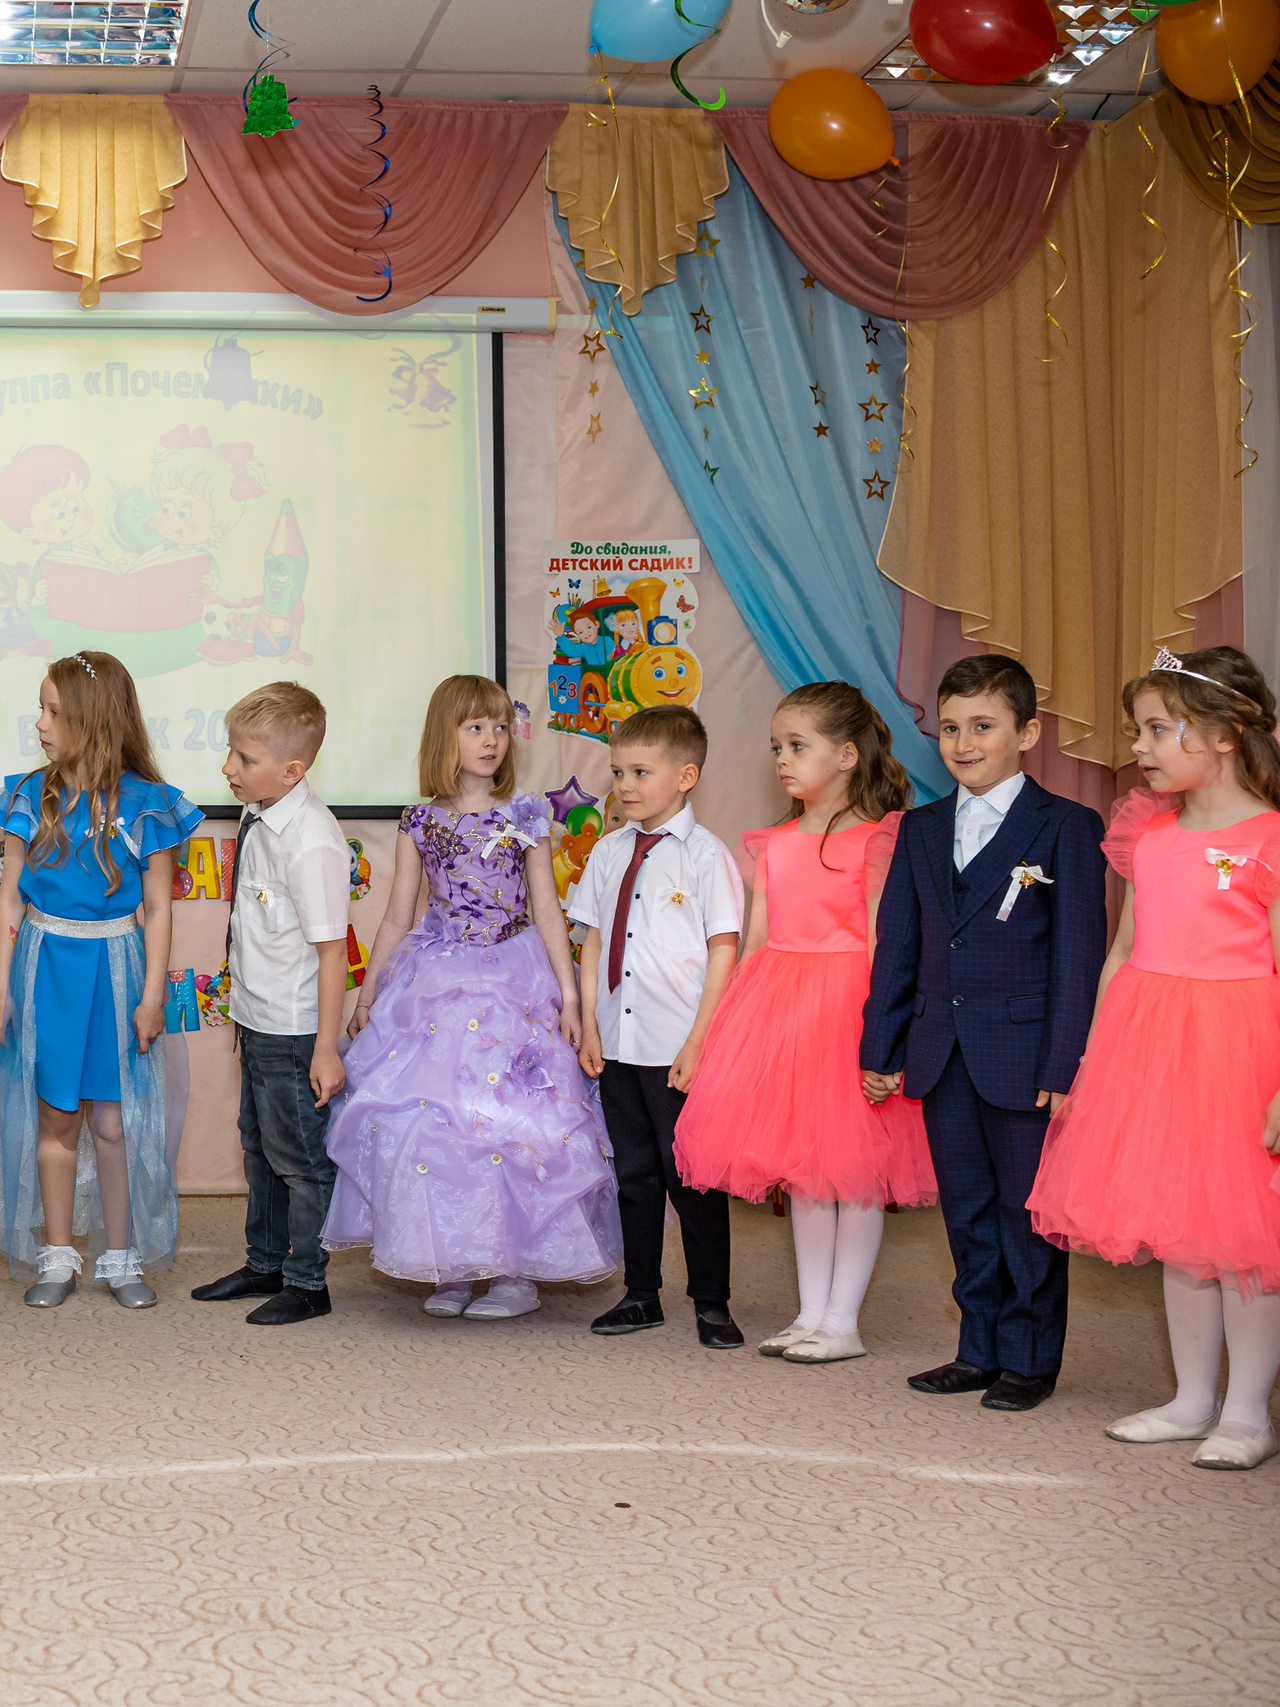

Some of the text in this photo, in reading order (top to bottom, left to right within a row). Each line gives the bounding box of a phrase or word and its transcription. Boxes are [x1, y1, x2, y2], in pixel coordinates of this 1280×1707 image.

[81, 361, 324, 420] «Почеки»
[570, 541, 672, 556] До свидания,
[549, 556, 693, 572] ДЕТСКИЙ САДИК!
[184, 708, 227, 752] 20
